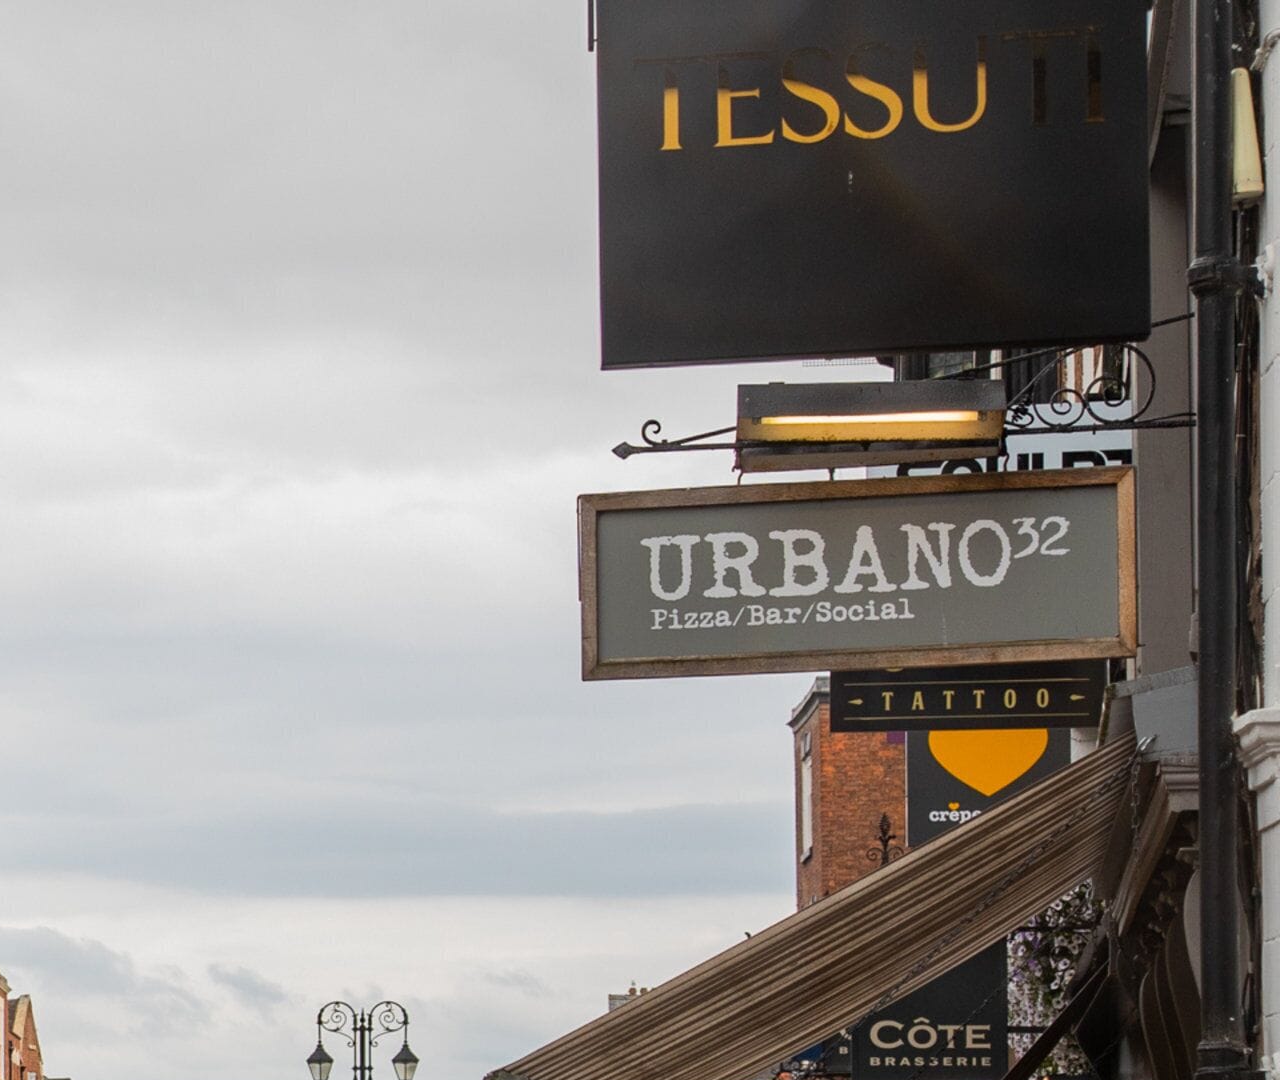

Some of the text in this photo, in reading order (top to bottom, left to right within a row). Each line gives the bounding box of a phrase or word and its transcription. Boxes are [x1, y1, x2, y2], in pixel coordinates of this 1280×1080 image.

[633, 24, 1106, 151] TESSUTI
[651, 599, 914, 630] Pizza/Bar/Social
[881, 688, 1050, 711] TATTOO
[870, 1017, 991, 1049] CÔTE
[870, 1056, 992, 1067] BRASSERIE
